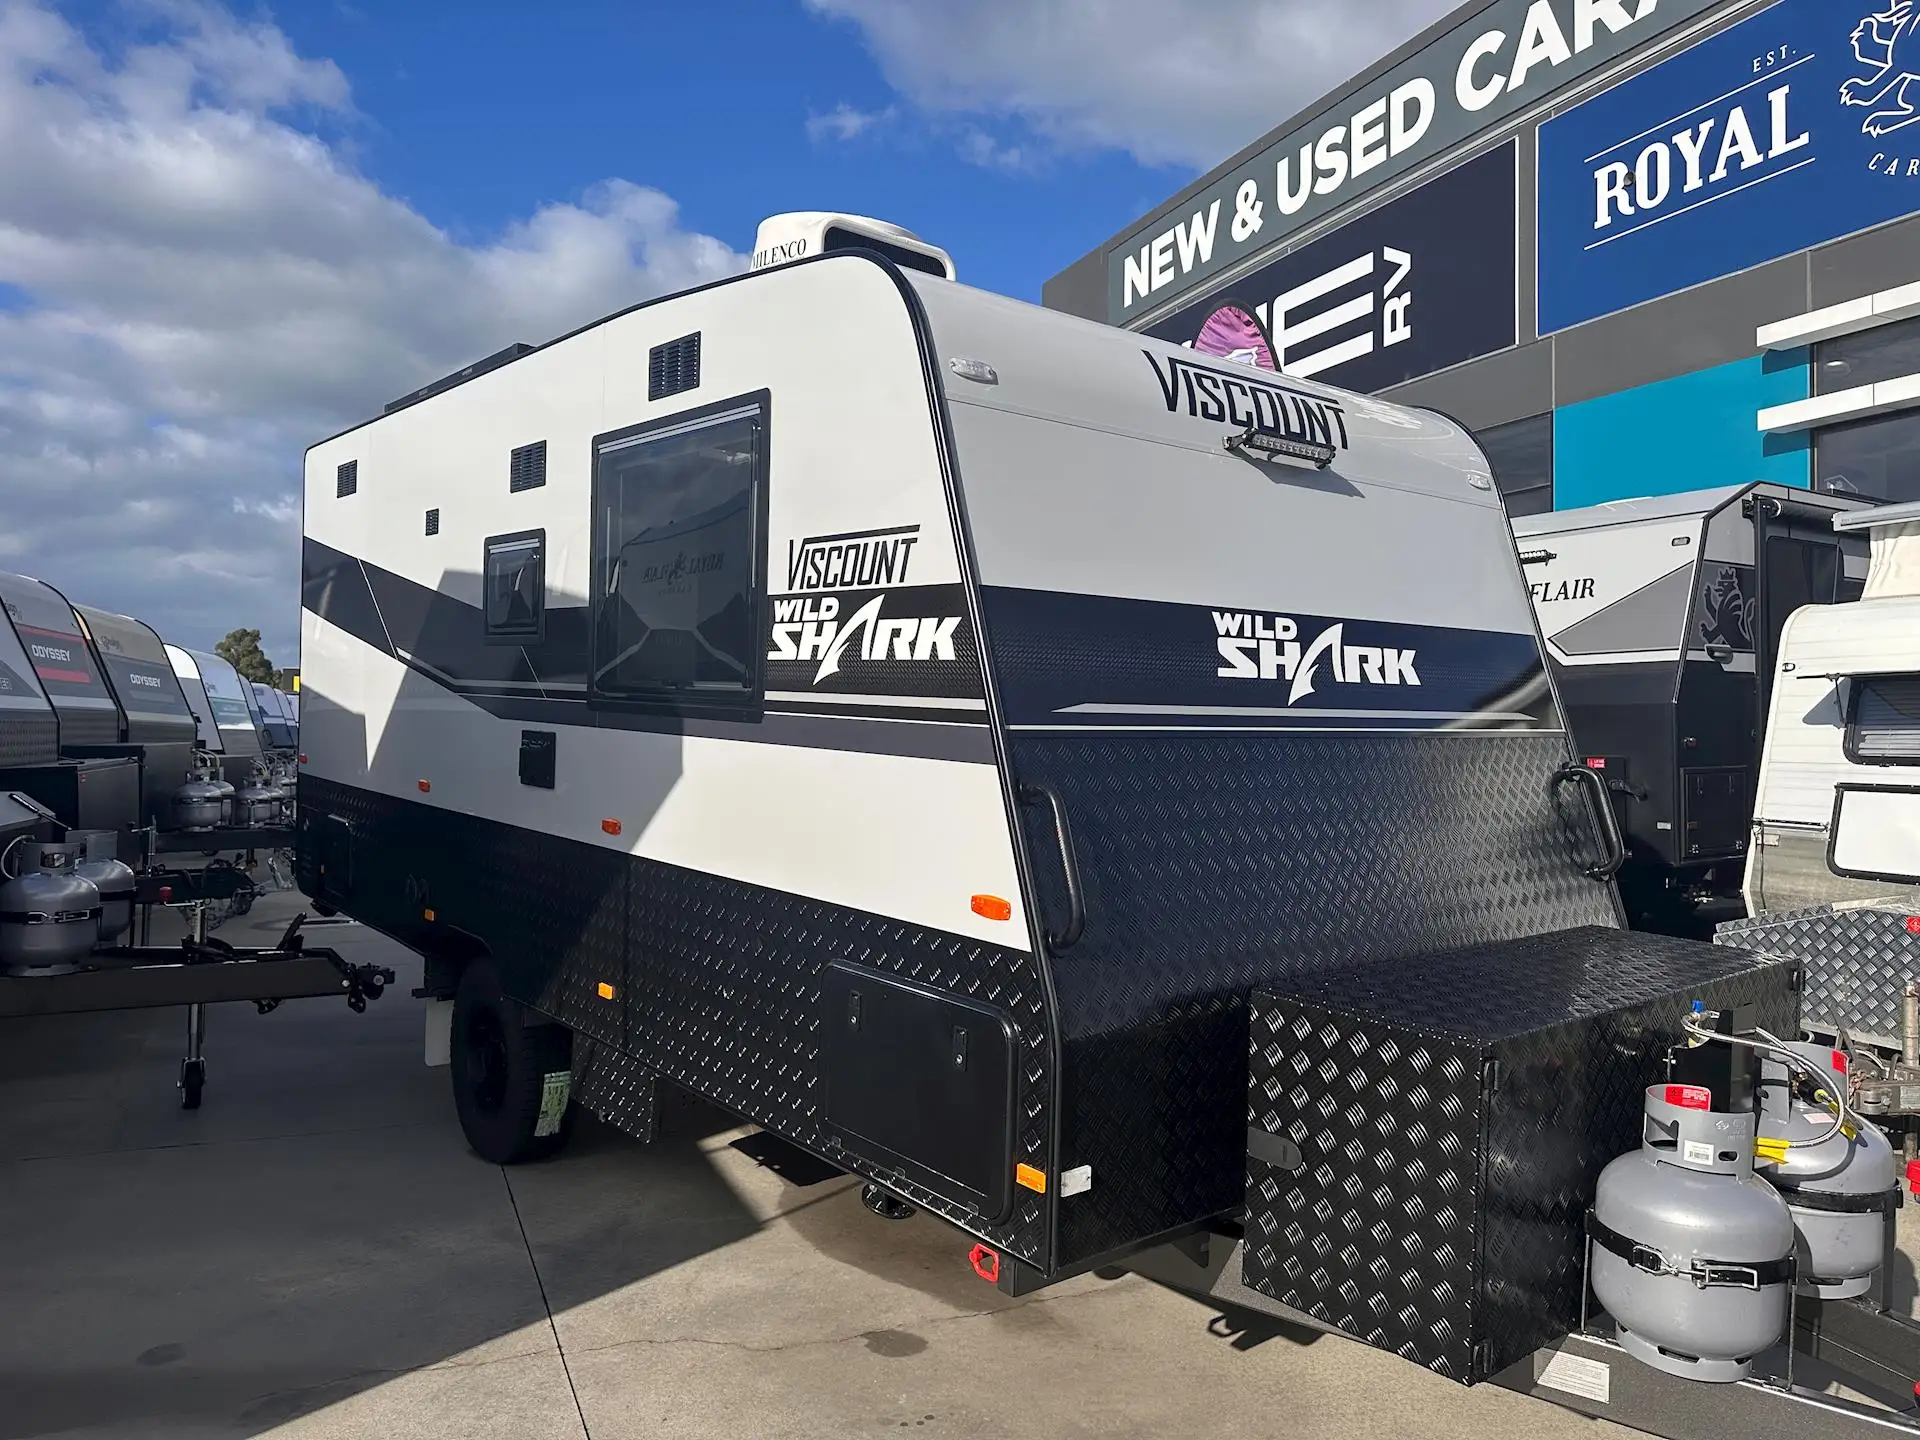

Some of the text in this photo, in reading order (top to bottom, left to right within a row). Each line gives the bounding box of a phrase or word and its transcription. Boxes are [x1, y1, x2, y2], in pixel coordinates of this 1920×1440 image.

[1752, 44, 1798, 72] EST.
[1123, 0, 1659, 308] NEW & USED CAR
[1593, 84, 1811, 230] ROYAL
[1383, 246, 1412, 347] RV
[1142, 349, 1349, 450] VISCOUNT
[788, 524, 921, 591] VISCOUNT
[767, 593, 962, 686] SHARK
[773, 596, 840, 622] WILD
[1211, 611, 1298, 640] WILD
[31, 644, 71, 662] ODYSSEY
[130, 673, 161, 688] ODYSSEY
[1217, 623, 1422, 706] SHARK
